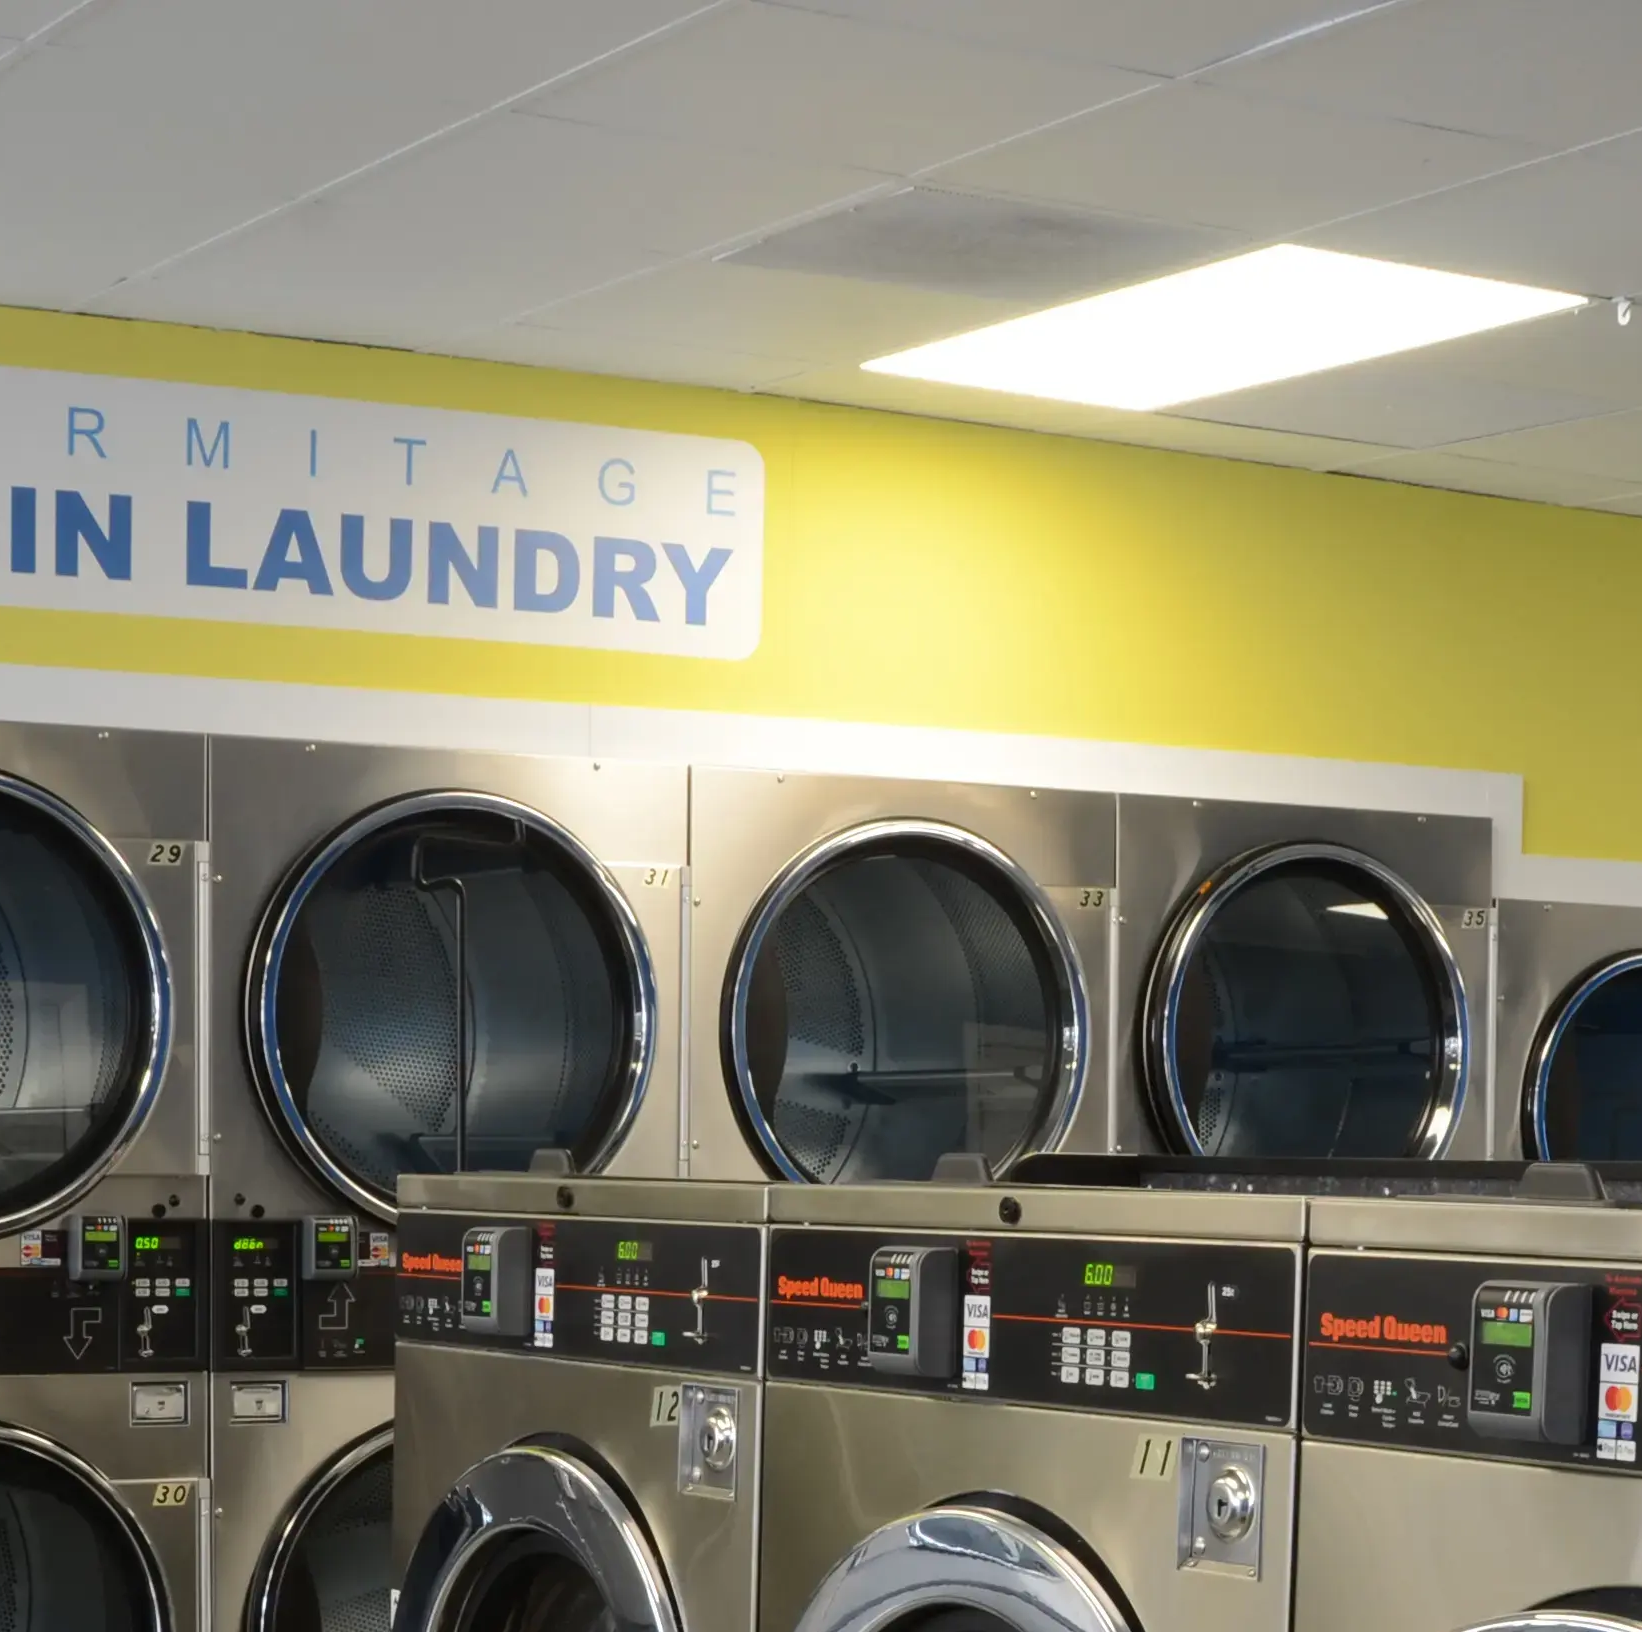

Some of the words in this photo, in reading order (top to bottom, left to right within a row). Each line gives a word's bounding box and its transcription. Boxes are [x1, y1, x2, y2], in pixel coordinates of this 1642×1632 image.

[185, 500, 734, 627] LAUNDRY
[150, 844, 181, 864] 29
[644, 868, 669, 886] 31
[1079, 890, 1104, 907] 33
[1464, 910, 1485, 927] 35
[536, 1275, 553, 1287] VISA
[1084, 1264, 1114, 1285] 6.00
[778, 1275, 819, 1299] Speed
[820, 1277, 864, 1299] Queen
[966, 1303, 989, 1319] VISA
[1612, 1309, 1630, 1321] Swipe
[1631, 1312, 1639, 1320] or
[1320, 1312, 1381, 1342] Speed
[1383, 1315, 1447, 1344] Queen
[1611, 1319, 1623, 1330] Tap
[1623, 1320, 1638, 1330] Here
[1603, 1353, 1638, 1374] VISA
[656, 1391, 679, 1422] 12
[1139, 1438, 1172, 1477] 11
[156, 1485, 186, 1504] 30
